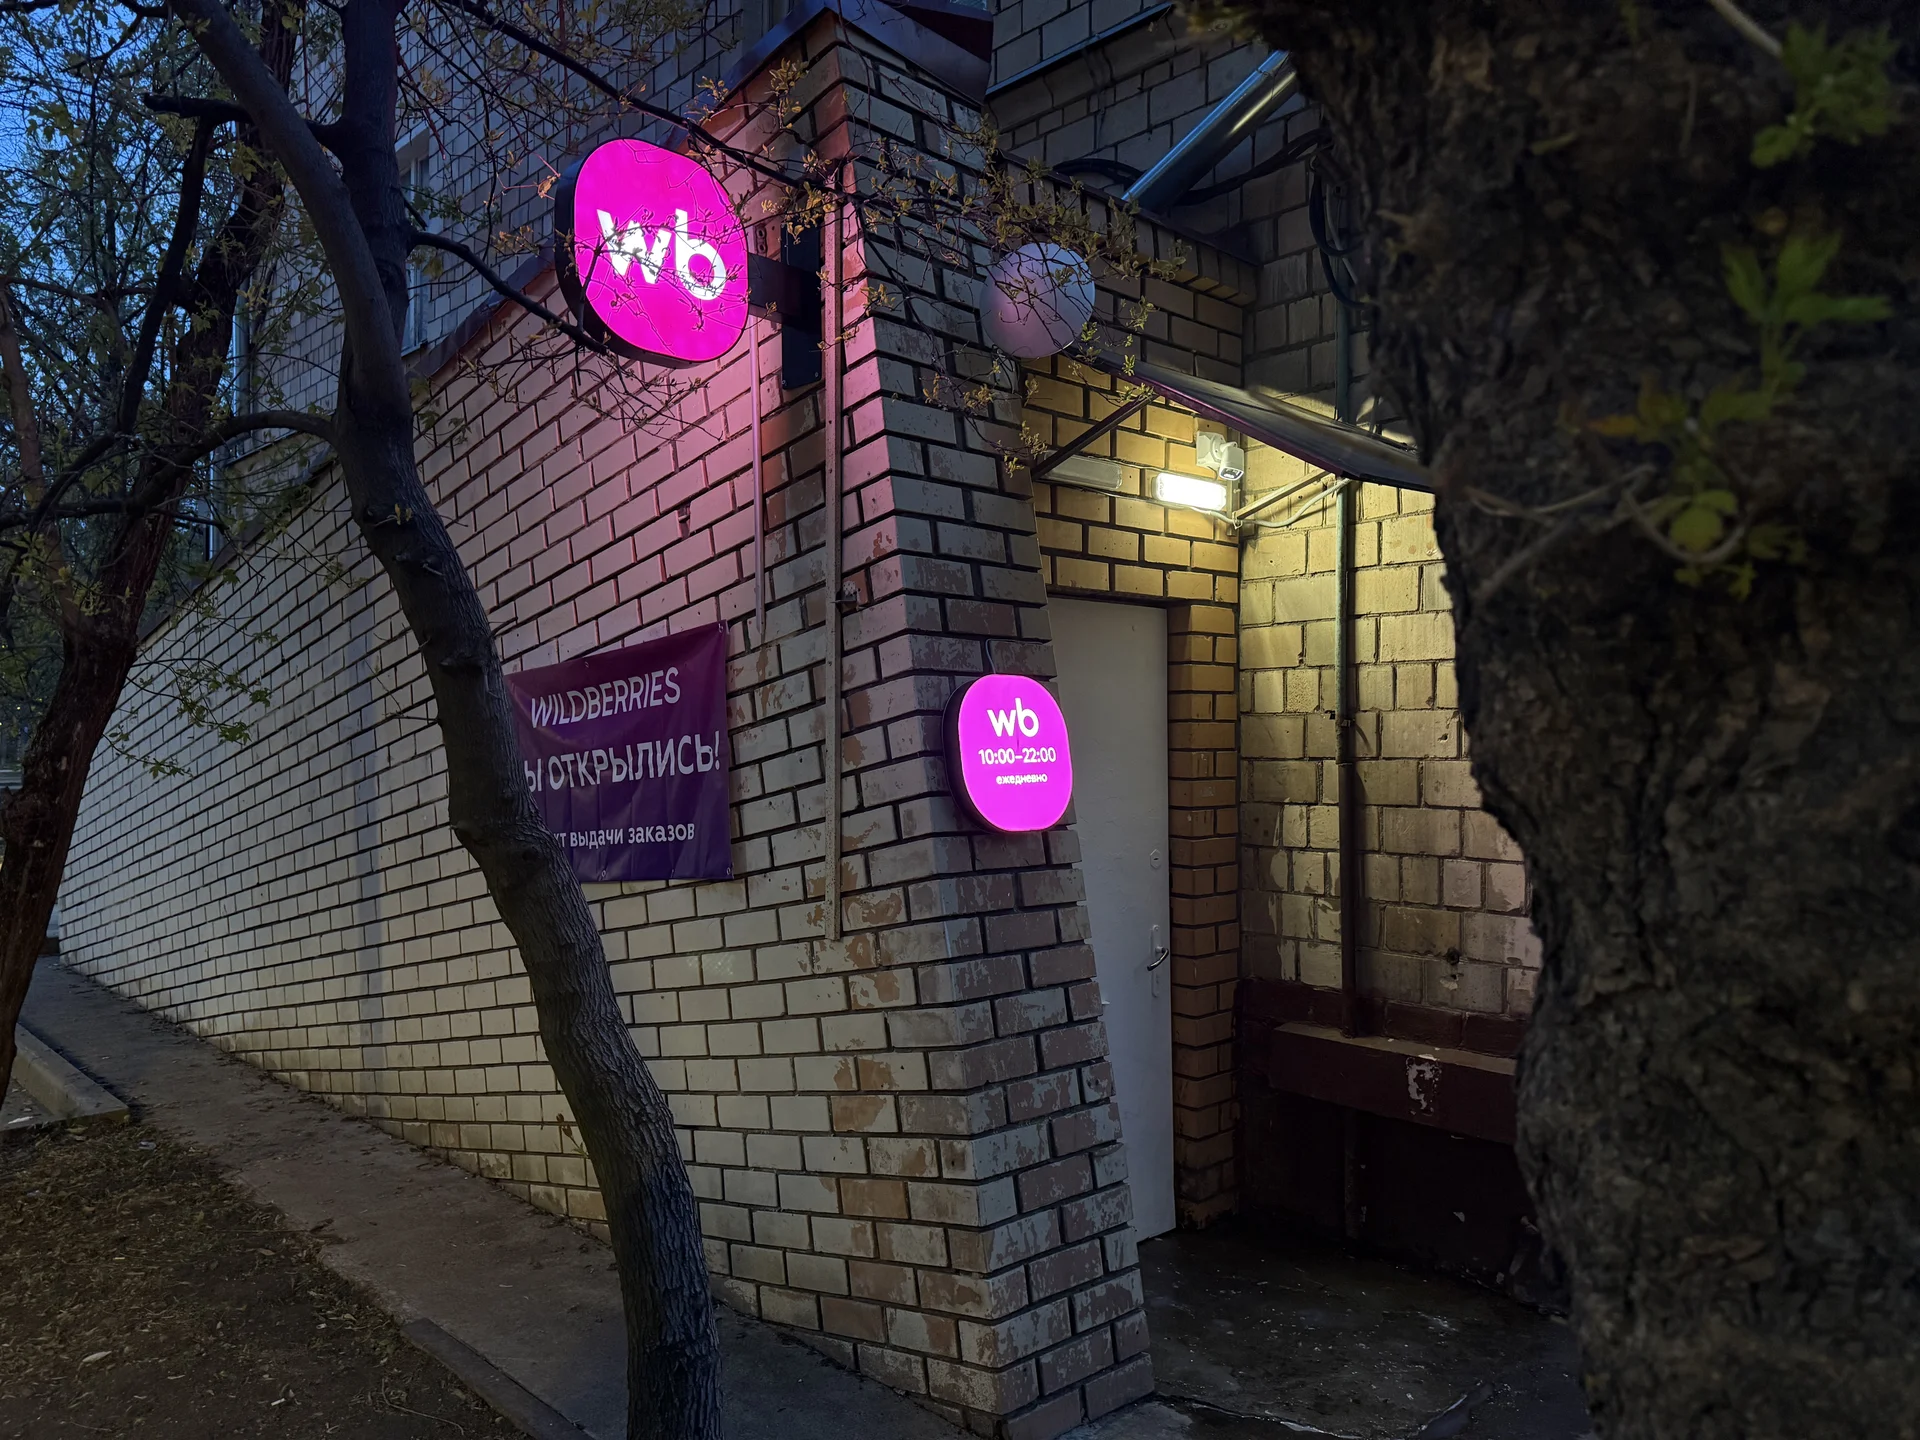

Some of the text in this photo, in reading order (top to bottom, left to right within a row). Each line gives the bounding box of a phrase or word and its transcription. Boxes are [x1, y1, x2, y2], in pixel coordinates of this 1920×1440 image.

[597, 208, 726, 300] wb
[531, 666, 681, 728] WILDBERRIES
[986, 697, 1040, 737] wb
[524, 730, 721, 792] Ы ОТКРЫЛИСЬ!
[996, 773, 1048, 785] ежедневно
[570, 828, 623, 849] выдачи
[628, 823, 695, 843] заказов
